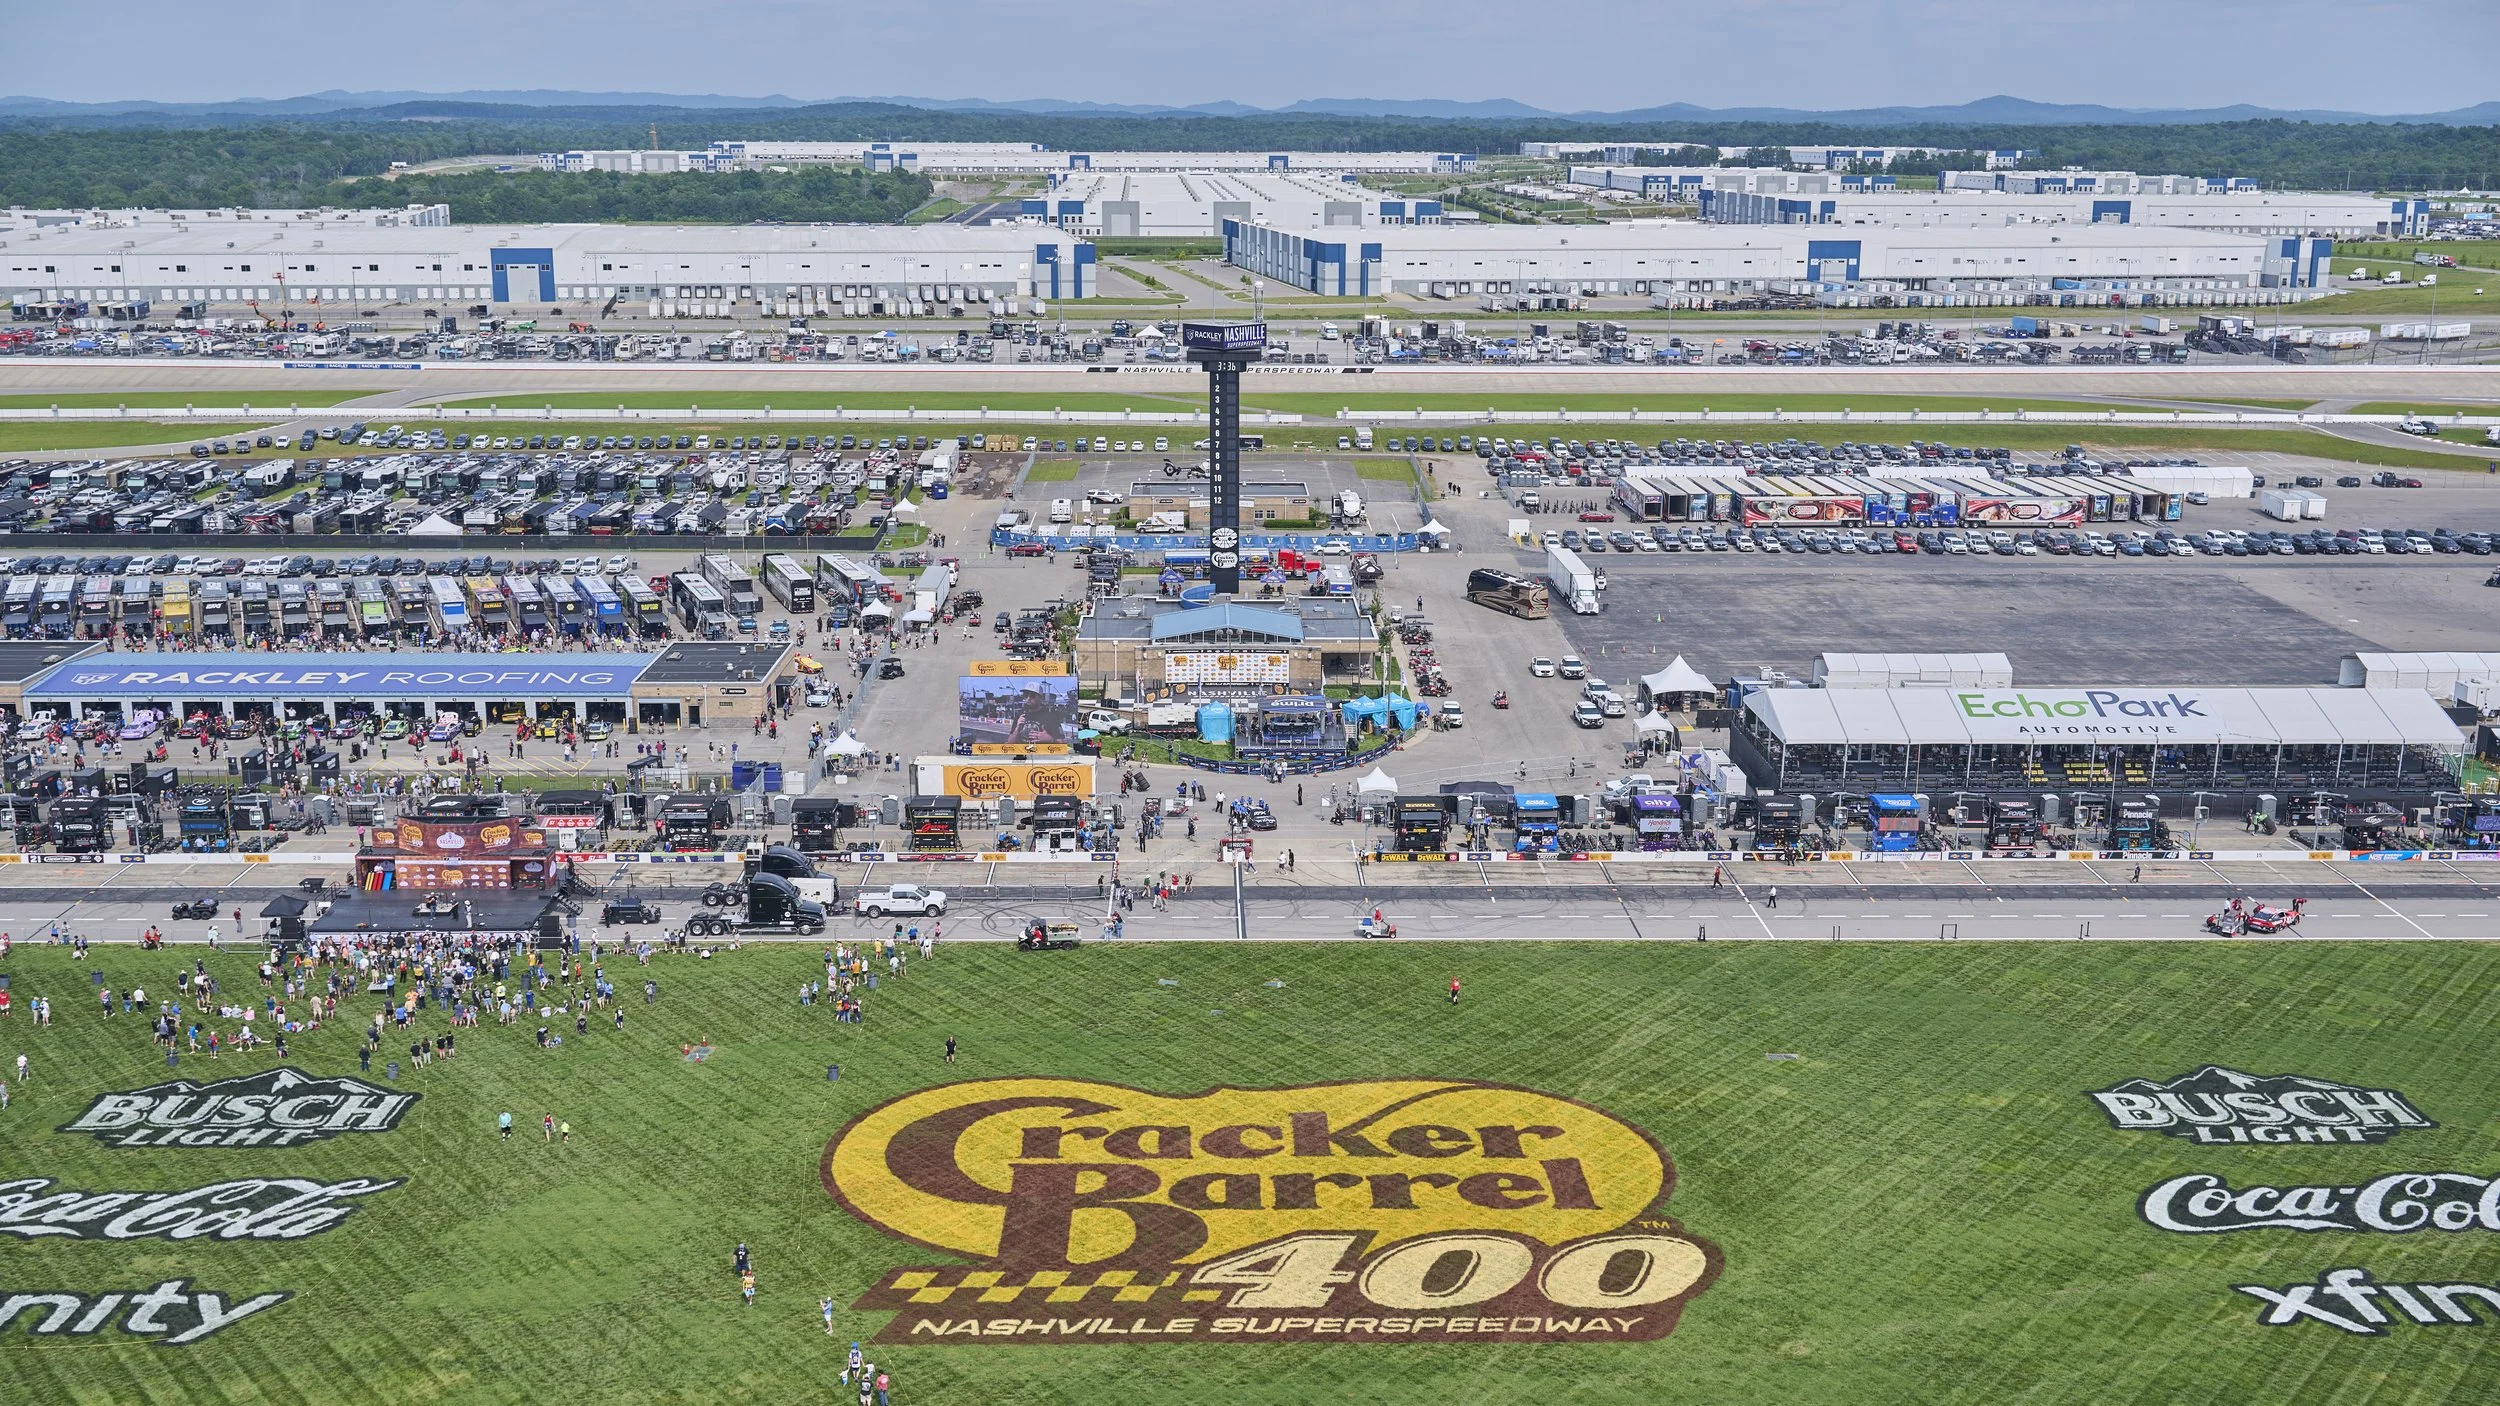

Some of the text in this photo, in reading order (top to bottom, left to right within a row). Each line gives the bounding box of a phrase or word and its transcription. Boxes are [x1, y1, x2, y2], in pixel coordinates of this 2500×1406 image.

[1194, 330, 1223, 341] RACKLEY
[1224, 325, 1266, 343] NASHVILLE
[1227, 340, 1263, 348] SUPERSPEEDWAY
[1218, 362, 1236, 371] 3:36
[1214, 554, 1234, 563] Cracker
[1217, 558, 1235, 566] Barrel
[119, 672, 614, 684] RACKLEY ROOFING
[1958, 691, 2207, 718] EchoPark
[2018, 726, 2178, 734] AUTOMOTIVE
[960, 771, 1005, 789] Cracker
[1030, 771, 1074, 789] Cracker
[969, 782, 1006, 796] Barrel
[1038, 782, 1076, 796] Barrel
[2124, 810, 2153, 818] Pinnacle
[495, 837, 510, 845] 400
[66, 1095, 413, 1131] BUSCH
[2095, 1091, 2432, 1128] BUSCH
[120, 1127, 315, 1146] LIGHT
[2196, 1126, 2367, 1143] LIGHT
[884, 1097, 1563, 1203] Cracker
[1000, 1157, 1604, 1265] Barrel
[1190, 1231, 1708, 1310] 400
[911, 1316, 1646, 1336] NASHVILLE SUPERSPEEDWAY
